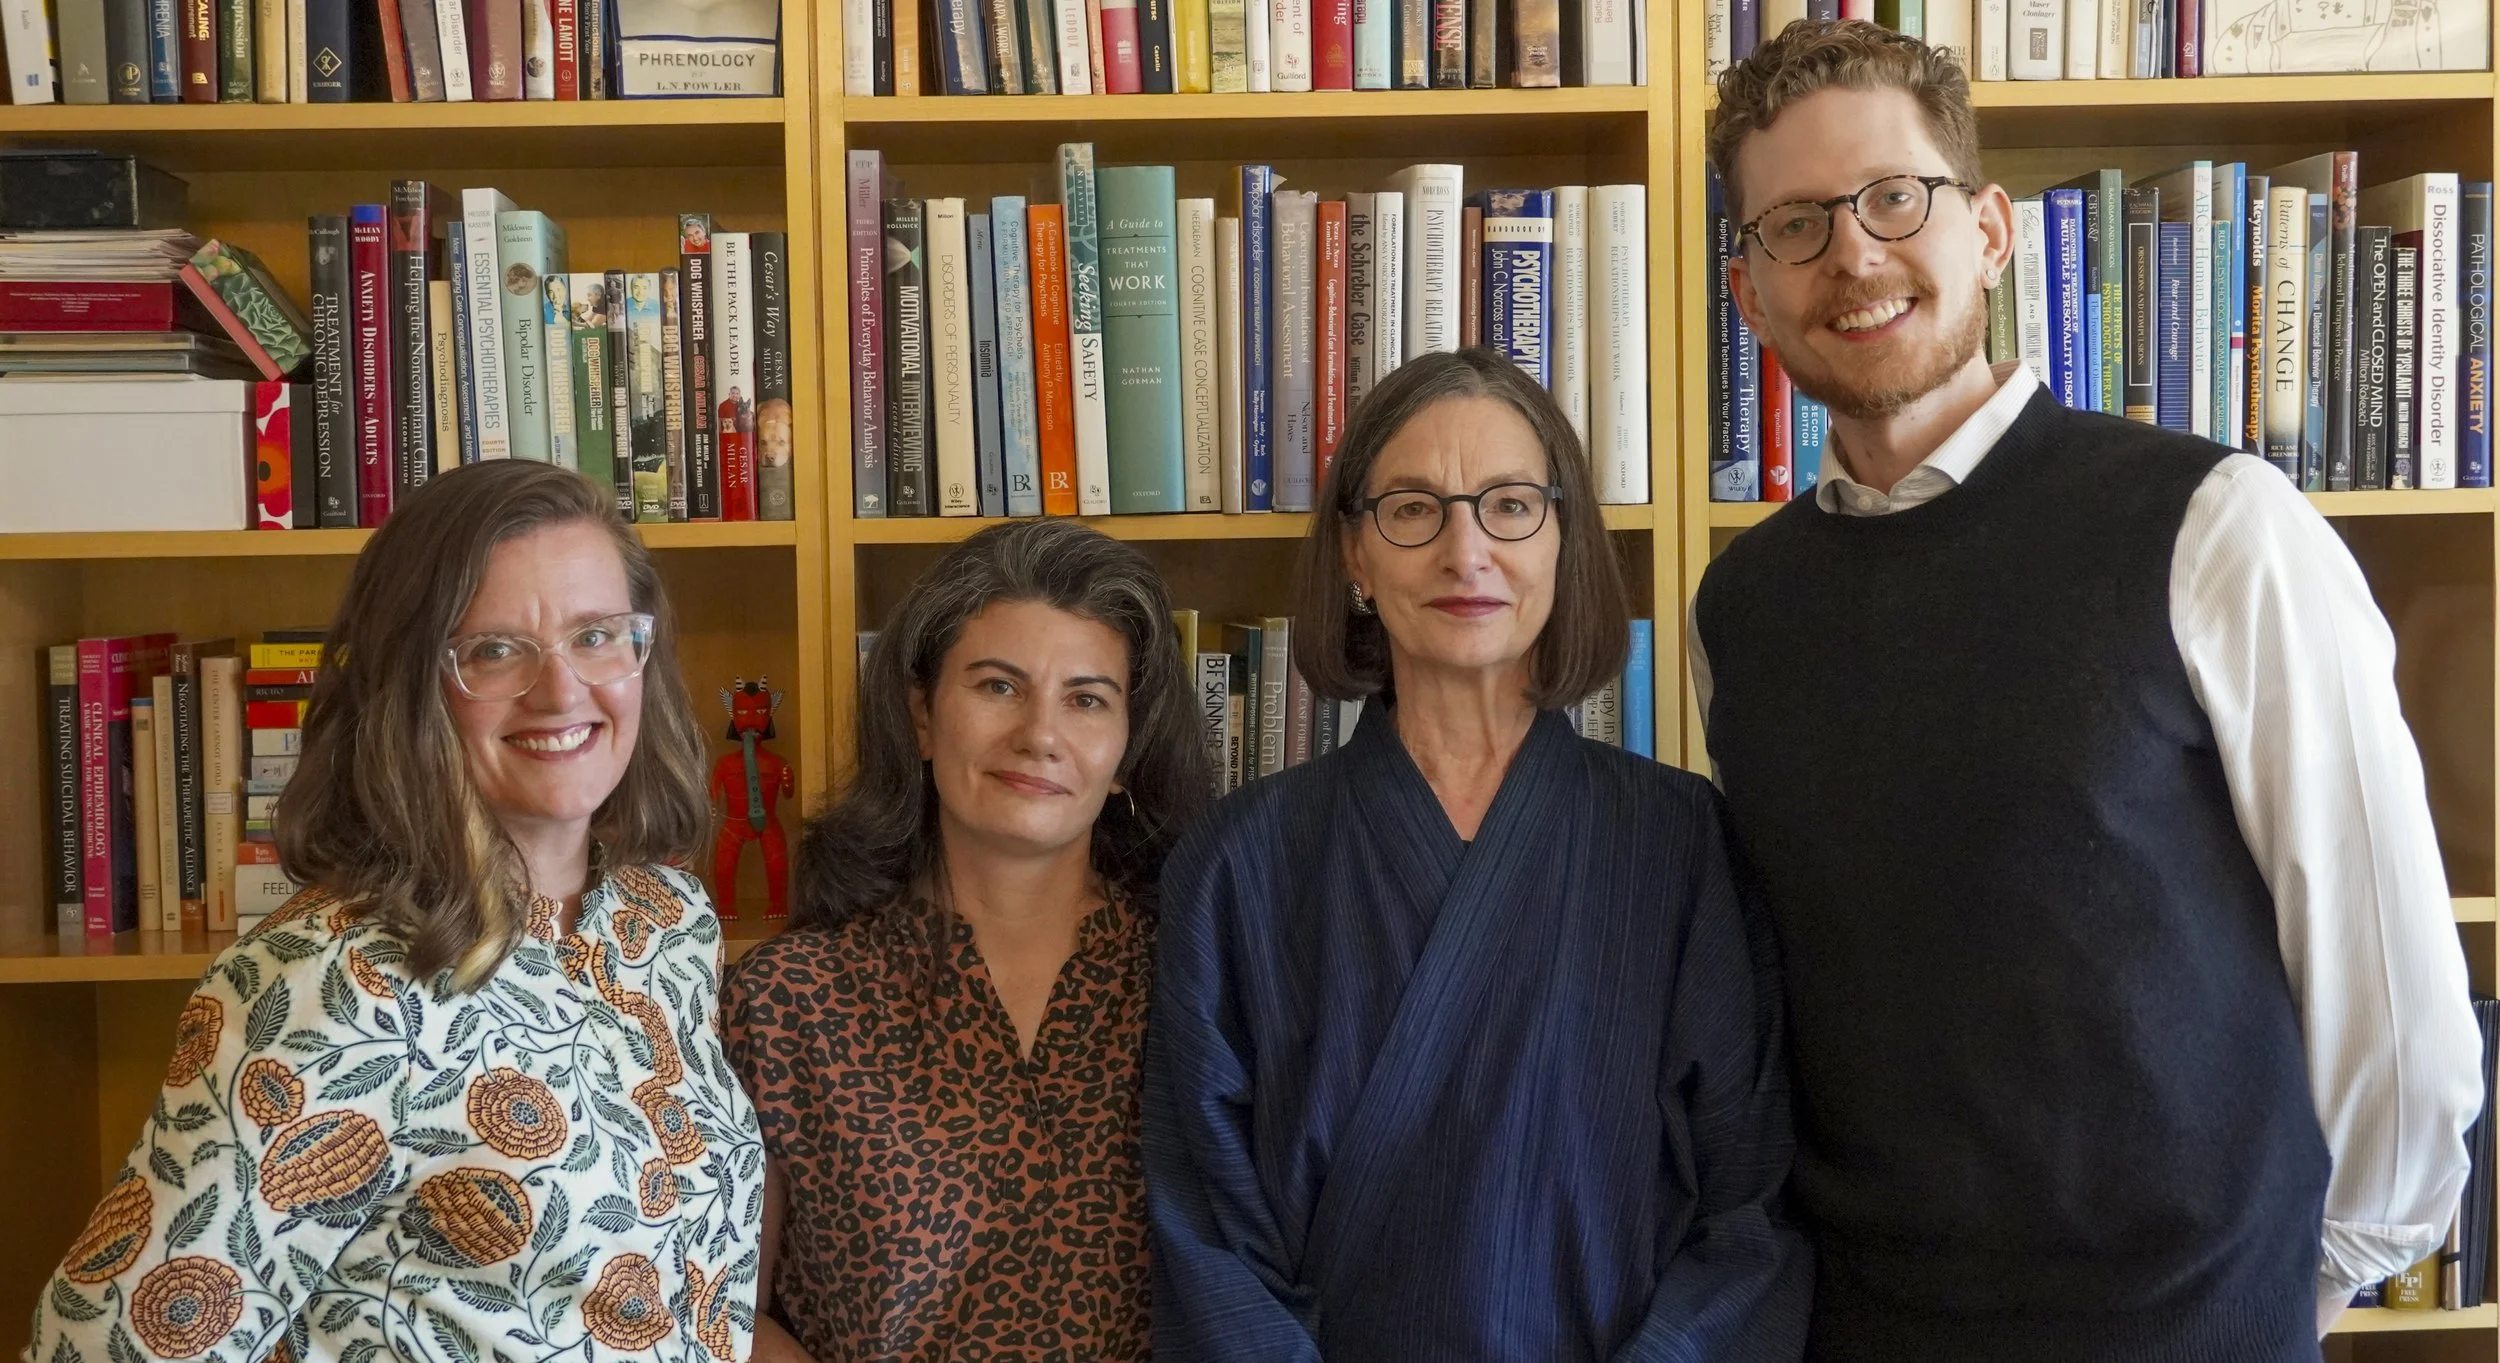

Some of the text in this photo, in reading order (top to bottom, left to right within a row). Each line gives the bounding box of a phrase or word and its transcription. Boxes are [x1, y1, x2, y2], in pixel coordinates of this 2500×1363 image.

[560, 18, 573, 62] LAMOTT
[639, 53, 755, 67] PHRENOLOGY
[1277, 72, 1306, 80] Guilford
[857, 179, 871, 208] Miller
[1077, 170, 1087, 223] NAJAVITS
[2427, 186, 2454, 194] Ross
[1008, 221, 1020, 261] Cognitive
[1035, 221, 1050, 317] Therapy for Psychosis
[360, 270, 375, 325] ANXIETY
[406, 255, 425, 314] Helping
[725, 241, 740, 377] BE THE PACK LEADER
[764, 251, 780, 337] Cesar's Way
[1009, 264, 1022, 298] Therapy
[1013, 301, 1023, 314] for
[1108, 277, 1166, 291] WORK
[1280, 222, 1296, 379] Behavioral Assessment
[1349, 214, 1372, 393] the Schreber Case William G.
[1491, 248, 1510, 341] John C. Norcross and
[2169, 279, 2181, 361] Fear and Courage
[2245, 199, 2264, 441] Reynolds Morita Psychotherapy
[2276, 199, 2295, 392] Patterns of CHANGE
[326, 293, 343, 415] TREATMENT for
[362, 327, 377, 399] DISORDERS
[410, 317, 424, 338] the
[473, 252, 501, 429] ESSENTIAL PSYCHOTHERAPIES
[662, 325, 679, 354] DOG
[858, 247, 878, 468] Principles of Everyday Behavior Analysis
[940, 255, 961, 425] DISORDERS OF PERSONALITY
[979, 340, 993, 379] Insomnia
[1013, 316, 1026, 360] Psychosis
[1075, 262, 1098, 402] Seeking SAFETY
[1190, 209, 1211, 475] NEEDLEMAN COGNITIVE CASE CONCEPTUALIZATION
[2102, 282, 2113, 412] PSYCHOLOGICAL THERAPY
[2370, 236, 2387, 427] The OPEN and CLOSED MIND
[2396, 252, 2414, 398] THE THREE CHRISTS OF YPSILANTI
[2429, 204, 2446, 446] Dissociative Identity Disorder
[2469, 233, 2485, 434] PATHOLOGICAL ANXIETY
[312, 293, 332, 478] CHRONIC DEPRESSION
[407, 341, 425, 446] Noncompliant
[435, 332, 451, 432] Psychodiagnosis
[514, 318, 536, 416] Bipolar Disorder
[550, 329, 571, 434] DOG WHISPERER
[587, 338, 601, 407] DOG WHISPERER
[664, 356, 681, 430] WHISPERER
[763, 347, 773, 390] MILLAN
[774, 351, 783, 385] CESAR
[899, 285, 923, 472] MOTIVATIONAL INTERVIEWING
[2358, 349, 2370, 427] Milton Rokeach
[364, 416, 379, 465] ADULTS
[614, 387, 629, 458] DOG WHISPERER
[1735, 384, 1755, 454] Therapy
[1800, 405, 1809, 446] EDITION
[1810, 405, 1818, 447] SECOND
[727, 443, 737, 489] MILLAN
[738, 446, 748, 483] CESAR
[1619, 461, 1627, 489] OXFORD
[212, 670, 222, 786] THE CENTER CANNOT HOLD
[1231, 736, 1239, 769] BEYOND
[1248, 730, 1256, 755] THERAPY
[1262, 680, 1283, 765] Problem
[59, 697, 76, 893] TREATING SUICIDAL BEHAVIOR
[92, 702, 105, 858] CLINICAL EPIDEMIOLOGY
[177, 683, 195, 893] NEGOTIATING THE THERAPEUTIC ALLIANCE
